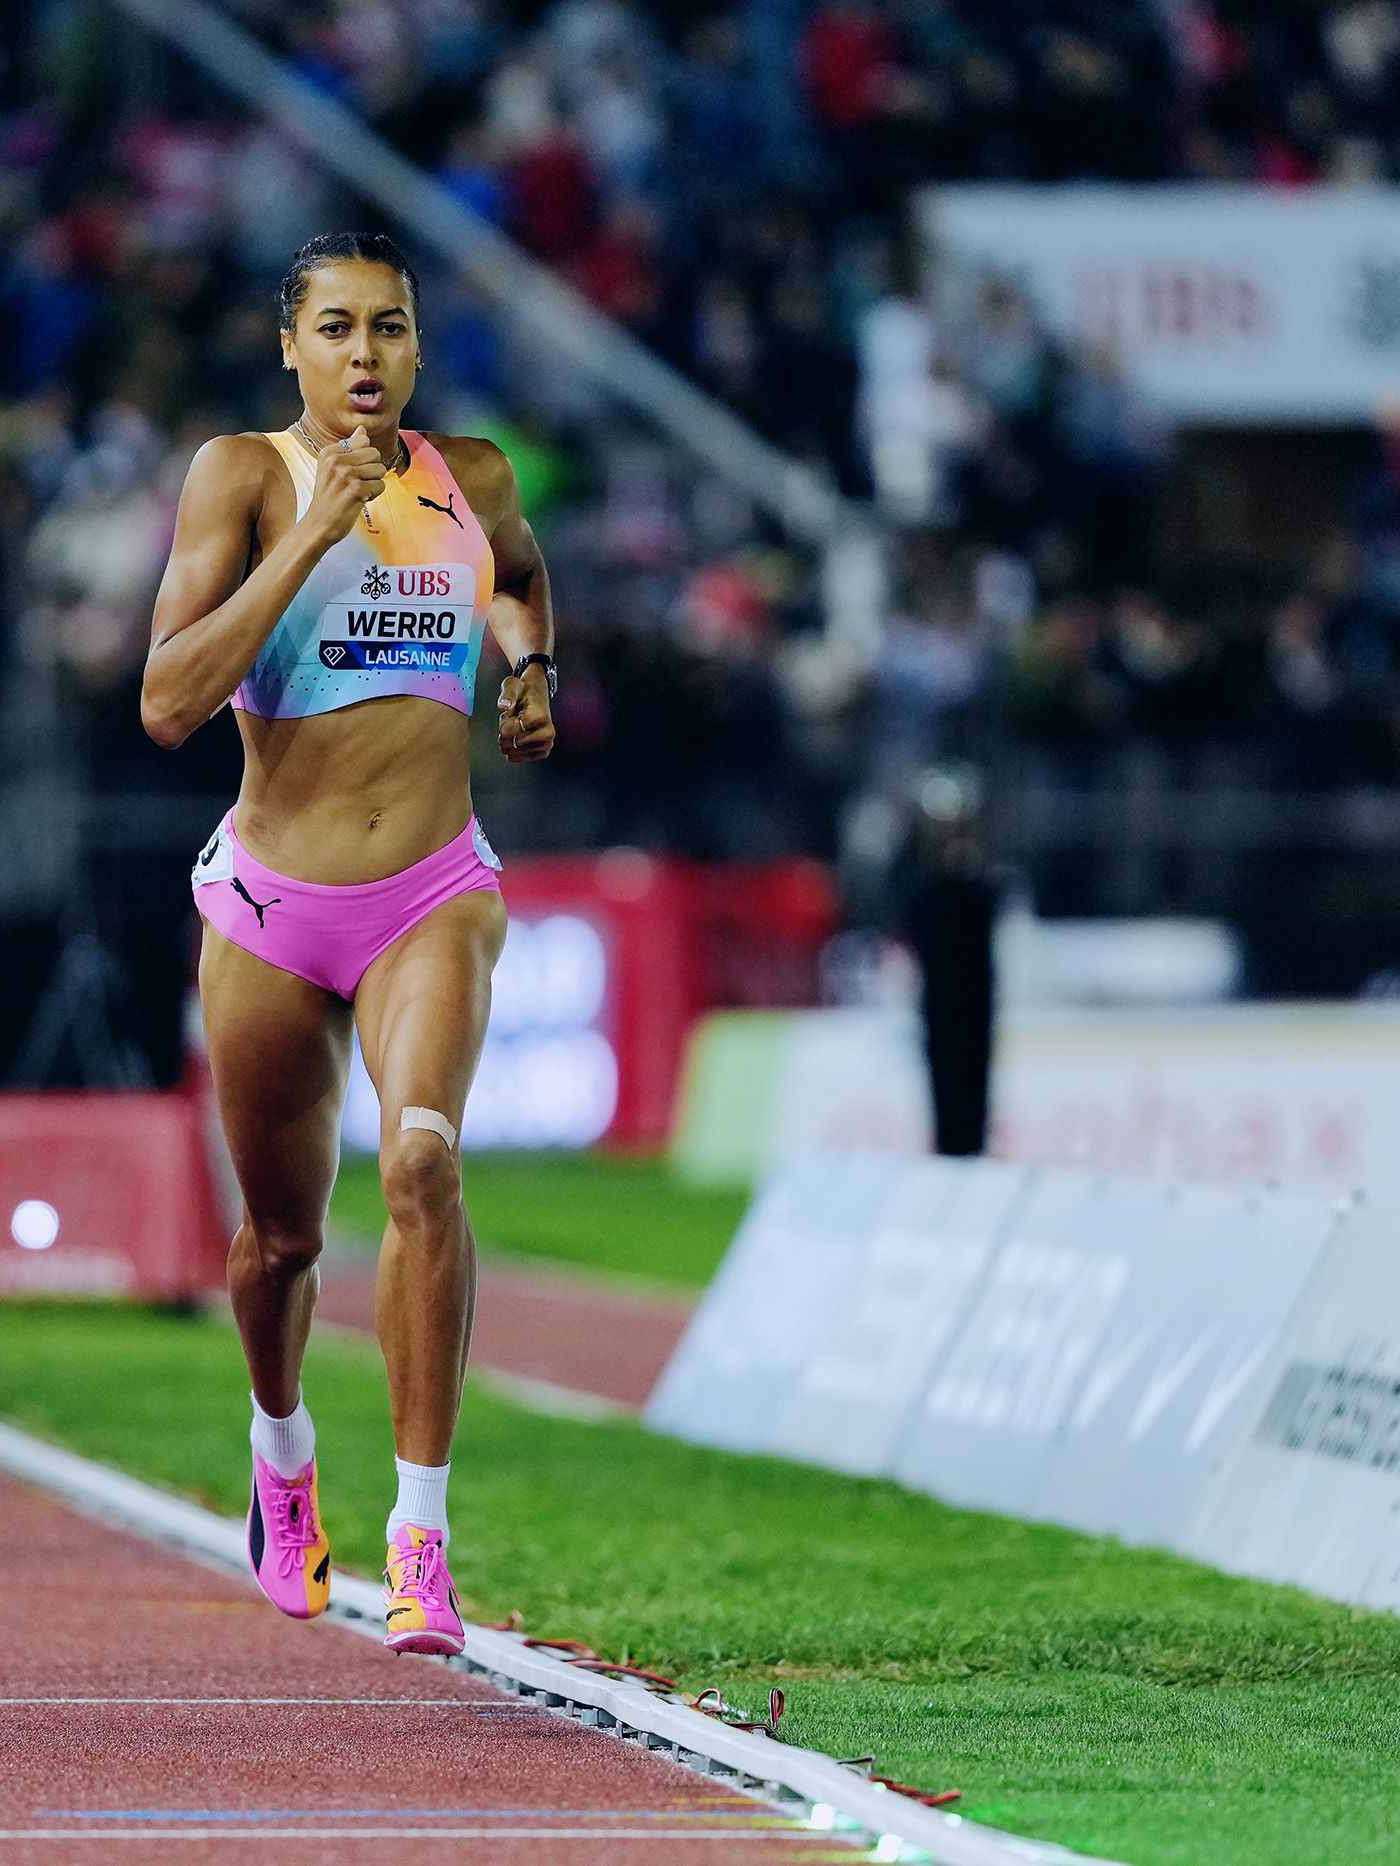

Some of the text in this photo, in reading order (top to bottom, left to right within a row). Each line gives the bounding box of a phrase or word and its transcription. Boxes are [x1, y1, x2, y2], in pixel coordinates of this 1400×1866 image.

[396, 570, 451, 596] UBS
[347, 610, 456, 639] WERRO
[365, 650, 451, 667] LAUSANNE
